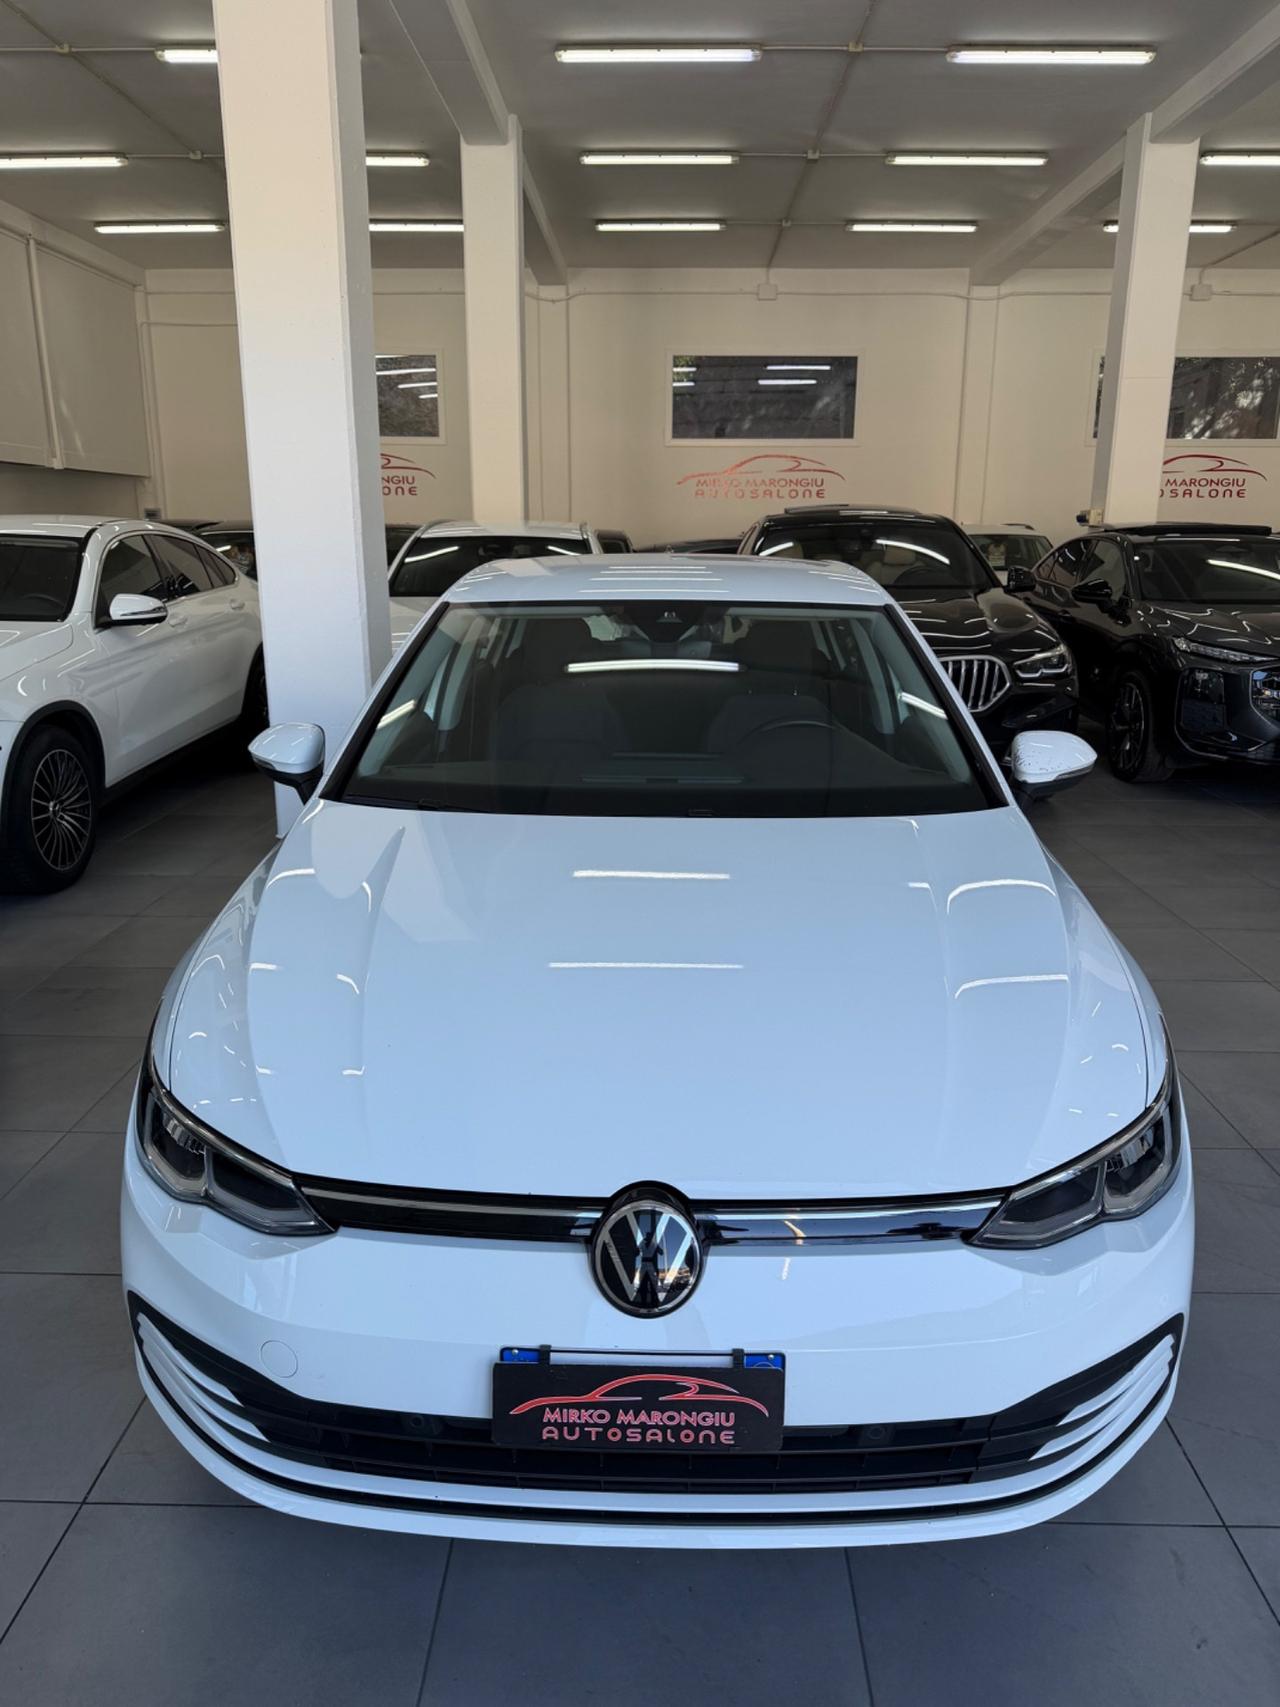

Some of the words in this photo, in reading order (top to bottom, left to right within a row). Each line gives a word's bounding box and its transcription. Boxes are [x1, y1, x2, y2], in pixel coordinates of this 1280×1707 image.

[381, 476, 416, 485] NGIU
[745, 478, 824, 488] MARONGIU
[1165, 478, 1246, 488] MARONGIU
[1160, 488, 1246, 498] SALONE
[543, 1407, 611, 1424] MIRKO
[616, 1409, 735, 1427] MARONGIU
[541, 1427, 736, 1444] AUTOSALONE
